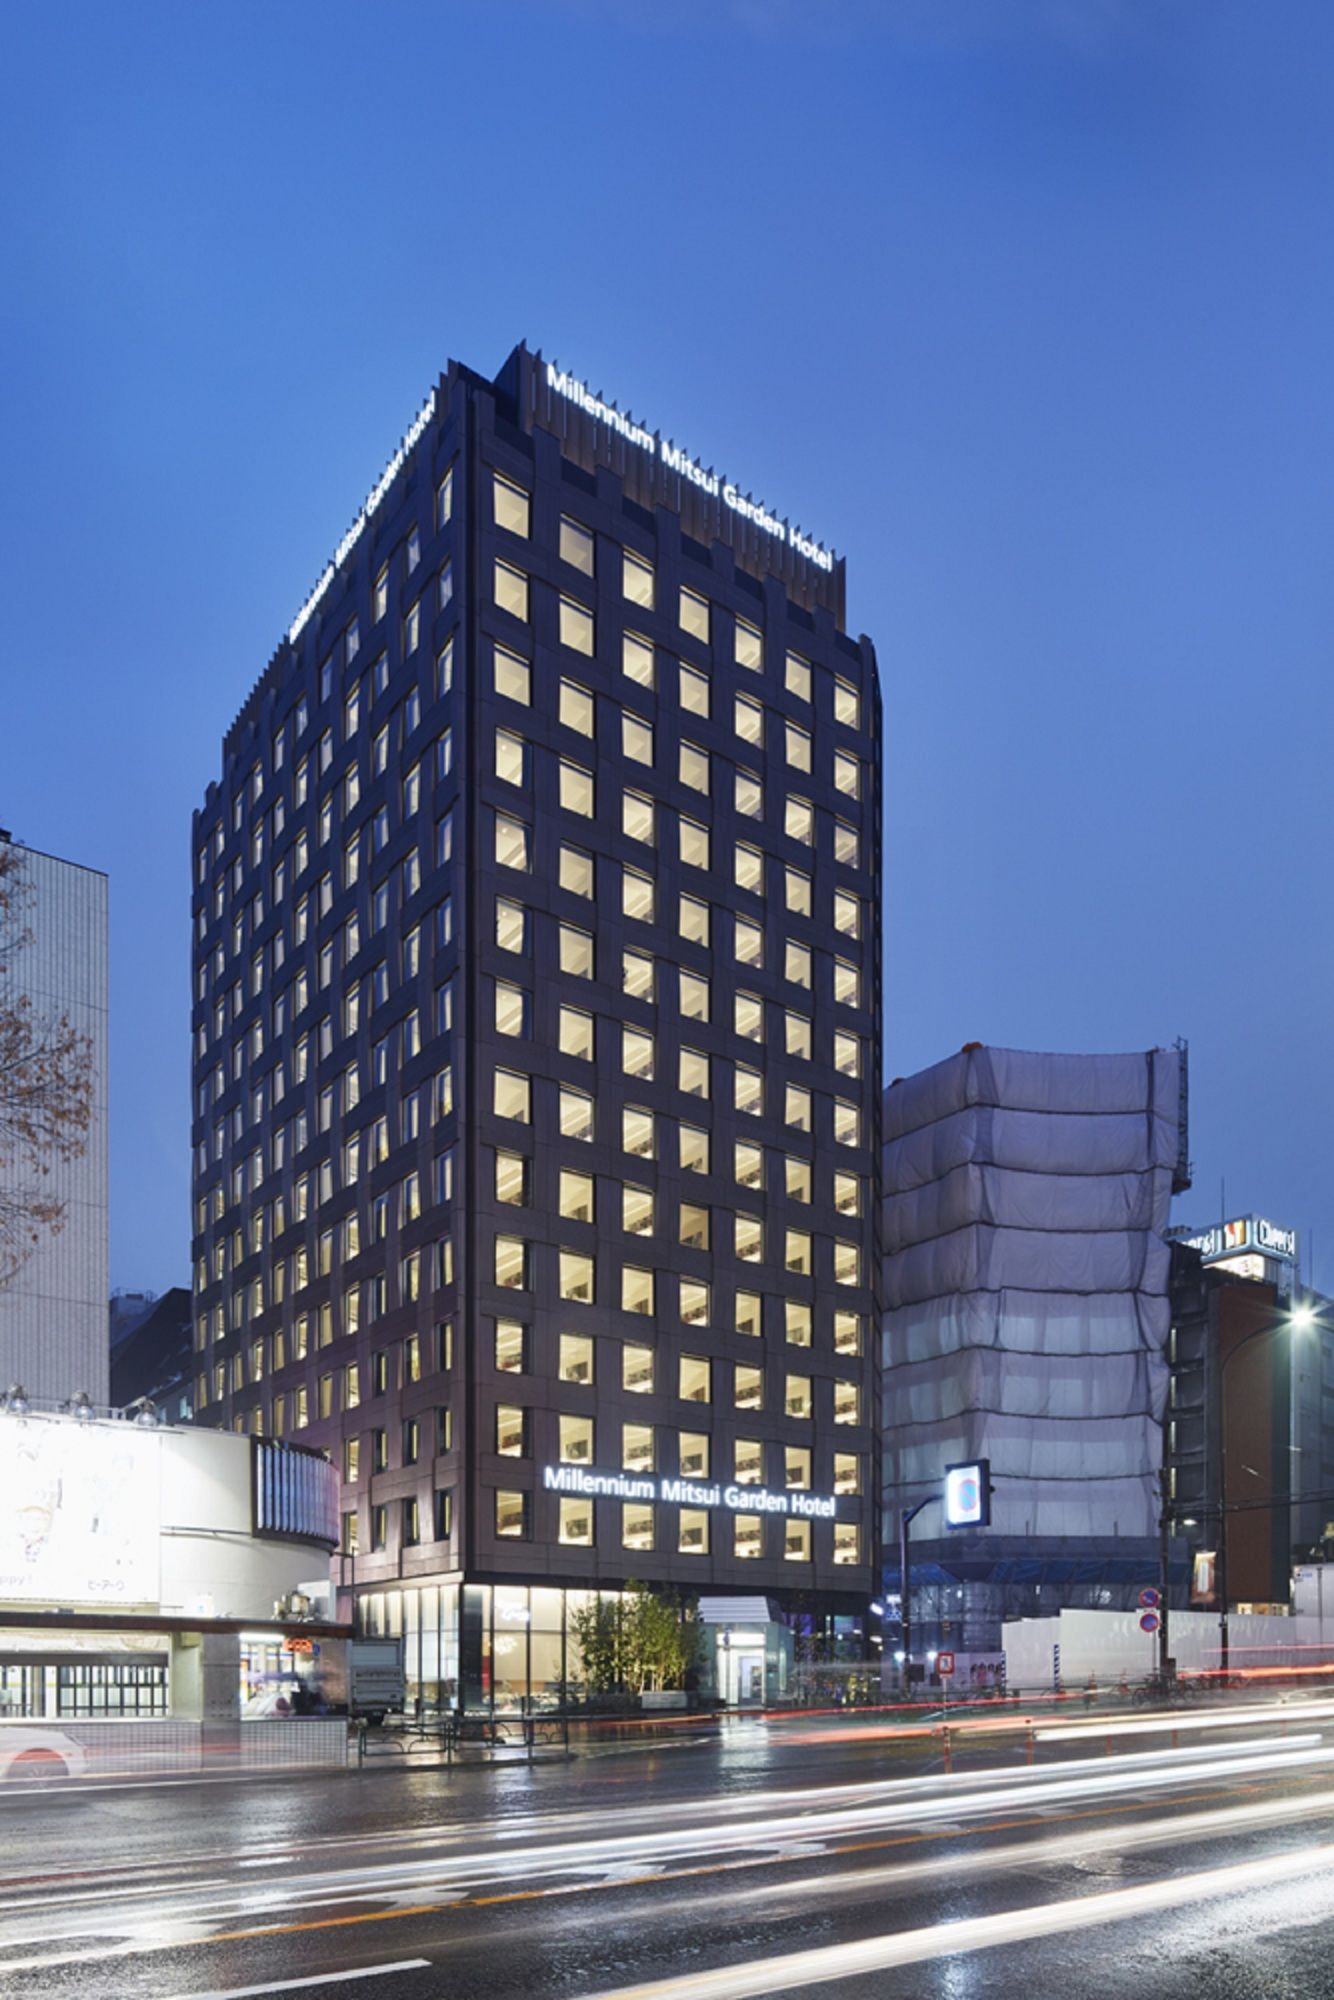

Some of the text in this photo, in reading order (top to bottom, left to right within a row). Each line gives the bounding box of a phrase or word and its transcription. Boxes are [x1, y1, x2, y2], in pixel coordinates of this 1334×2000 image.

[547, 363, 832, 573] Millennium Mitsui Garden Hotel
[544, 1465, 836, 1517] Millennium Mitsui Garden Hotel
